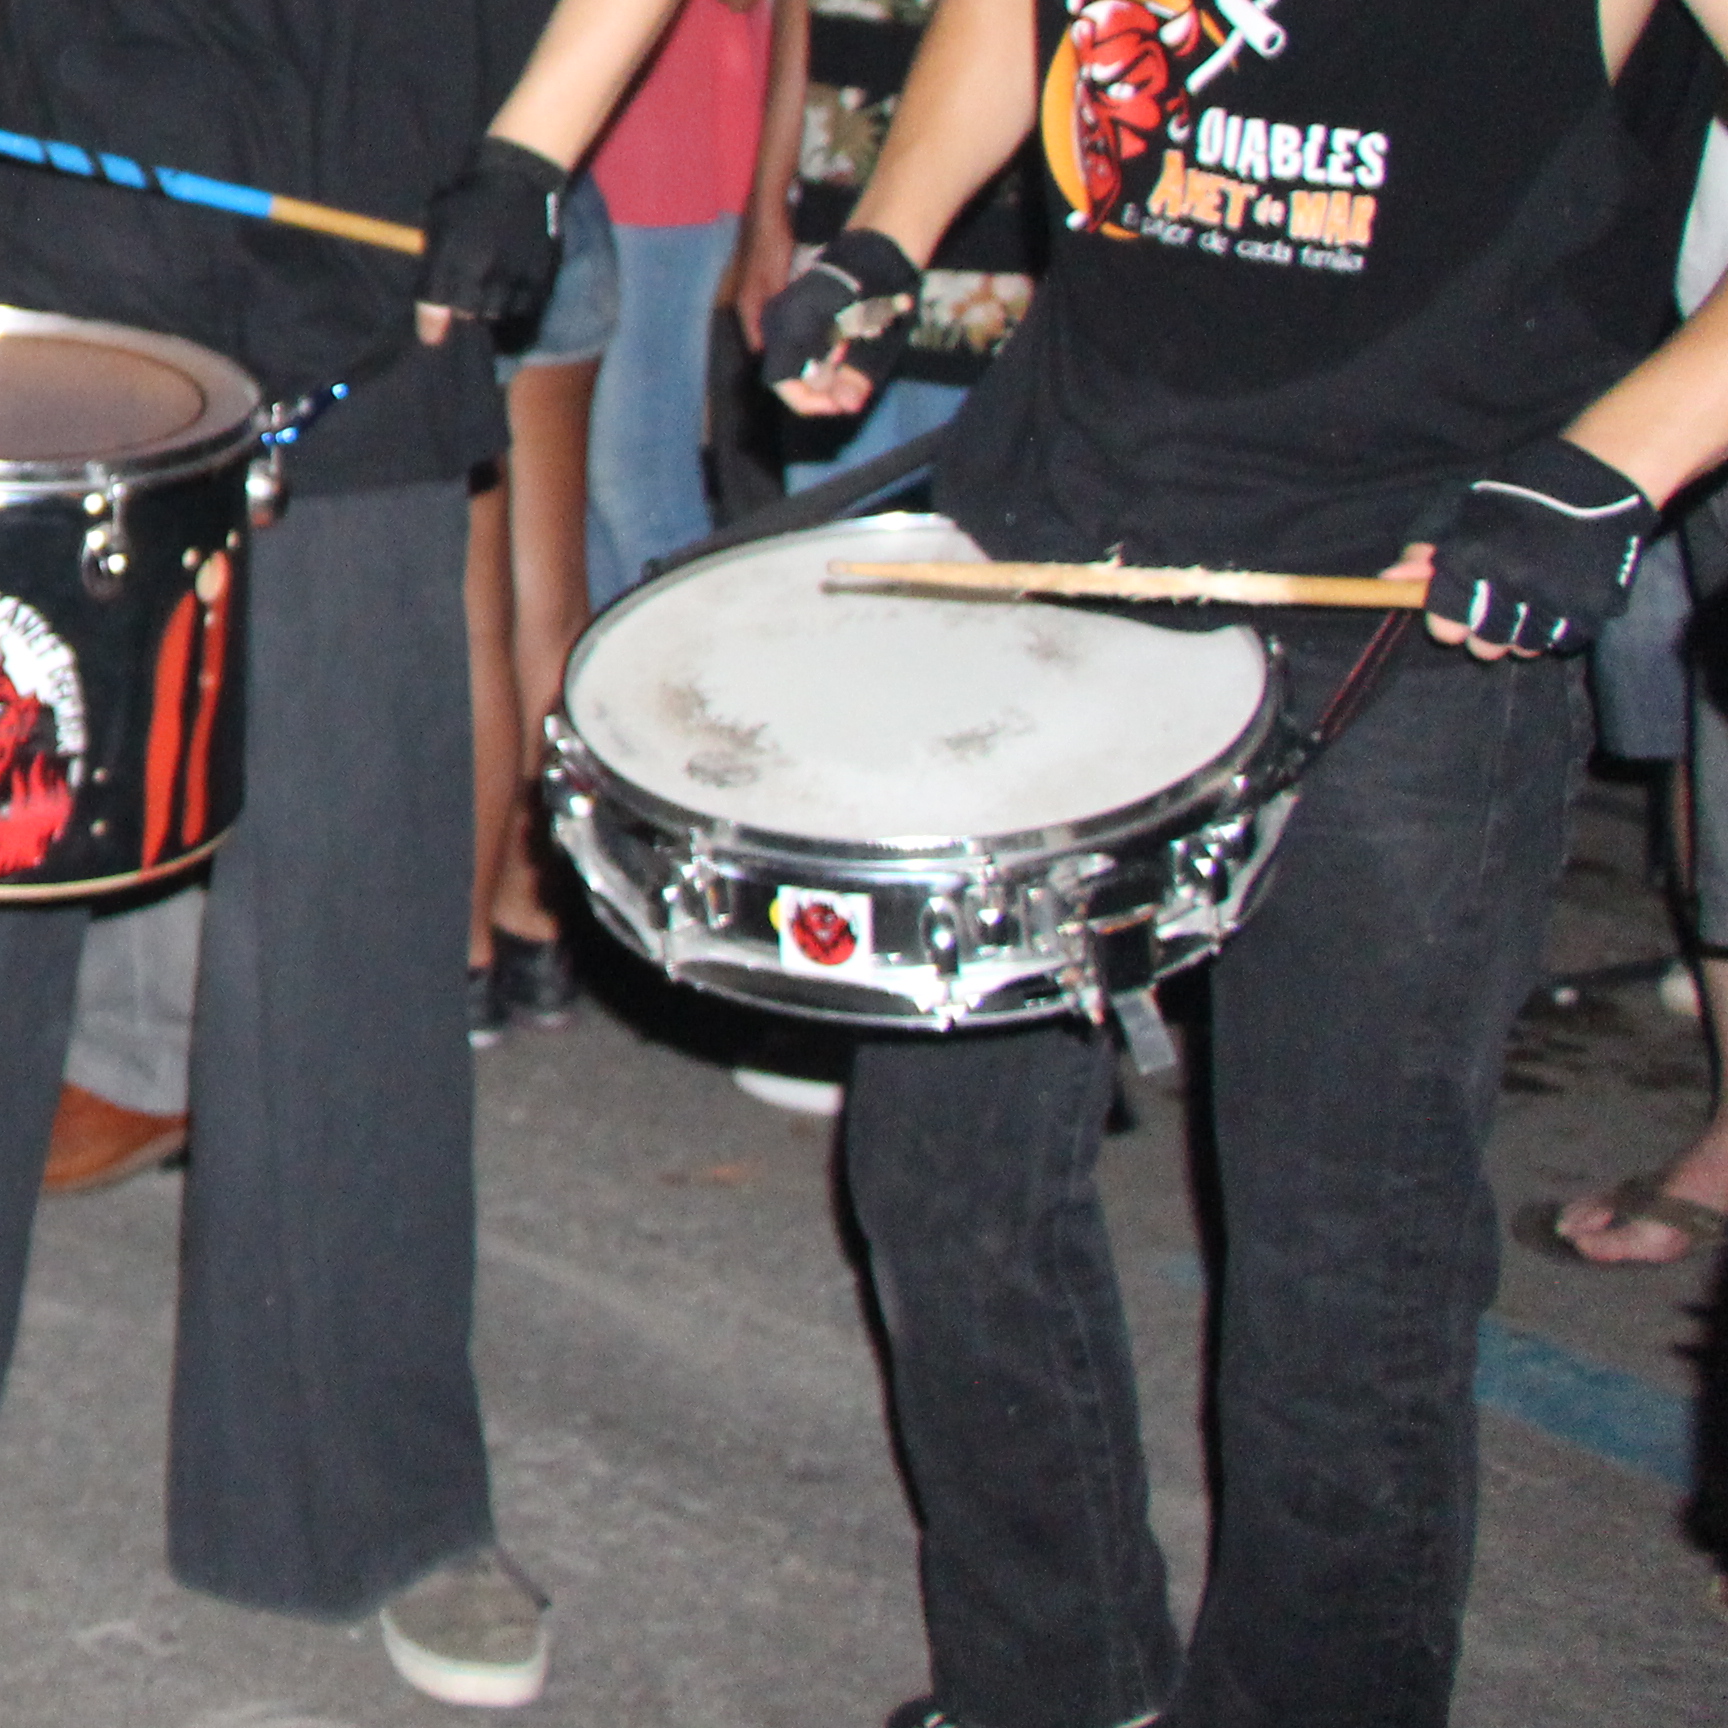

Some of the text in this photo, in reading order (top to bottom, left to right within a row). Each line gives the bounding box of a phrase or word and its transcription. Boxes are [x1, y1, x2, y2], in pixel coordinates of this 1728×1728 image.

[1197, 106, 1390, 189] DIABLES
[1253, 193, 1287, 227] de
[1289, 190, 1377, 248] MAR
